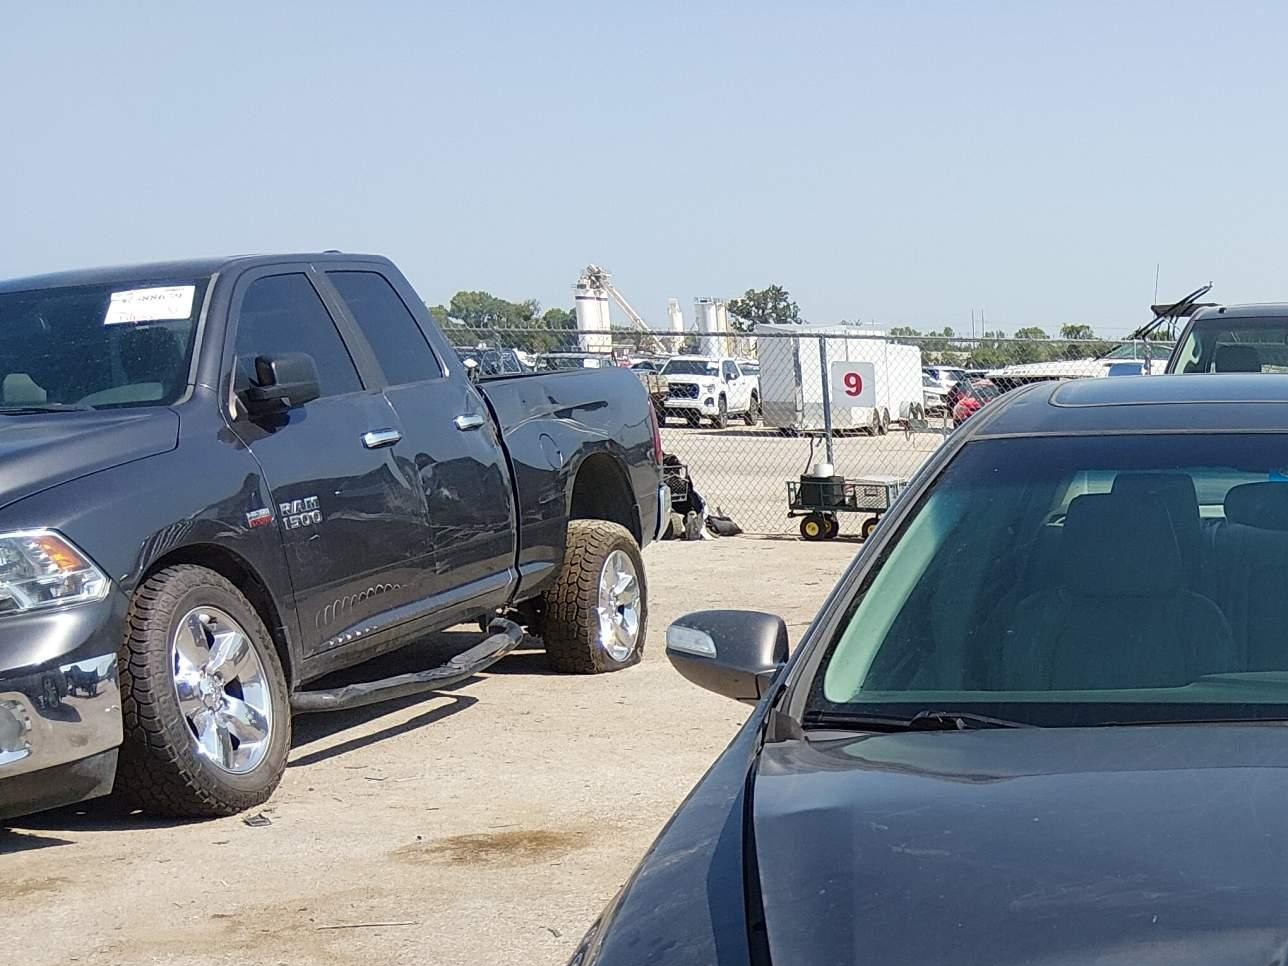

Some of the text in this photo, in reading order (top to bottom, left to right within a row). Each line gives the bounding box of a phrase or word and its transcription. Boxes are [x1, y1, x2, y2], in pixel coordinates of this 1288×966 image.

[843, 372, 863, 397] 9
[279, 495, 320, 516] RAM
[283, 509, 322, 530] 1500
